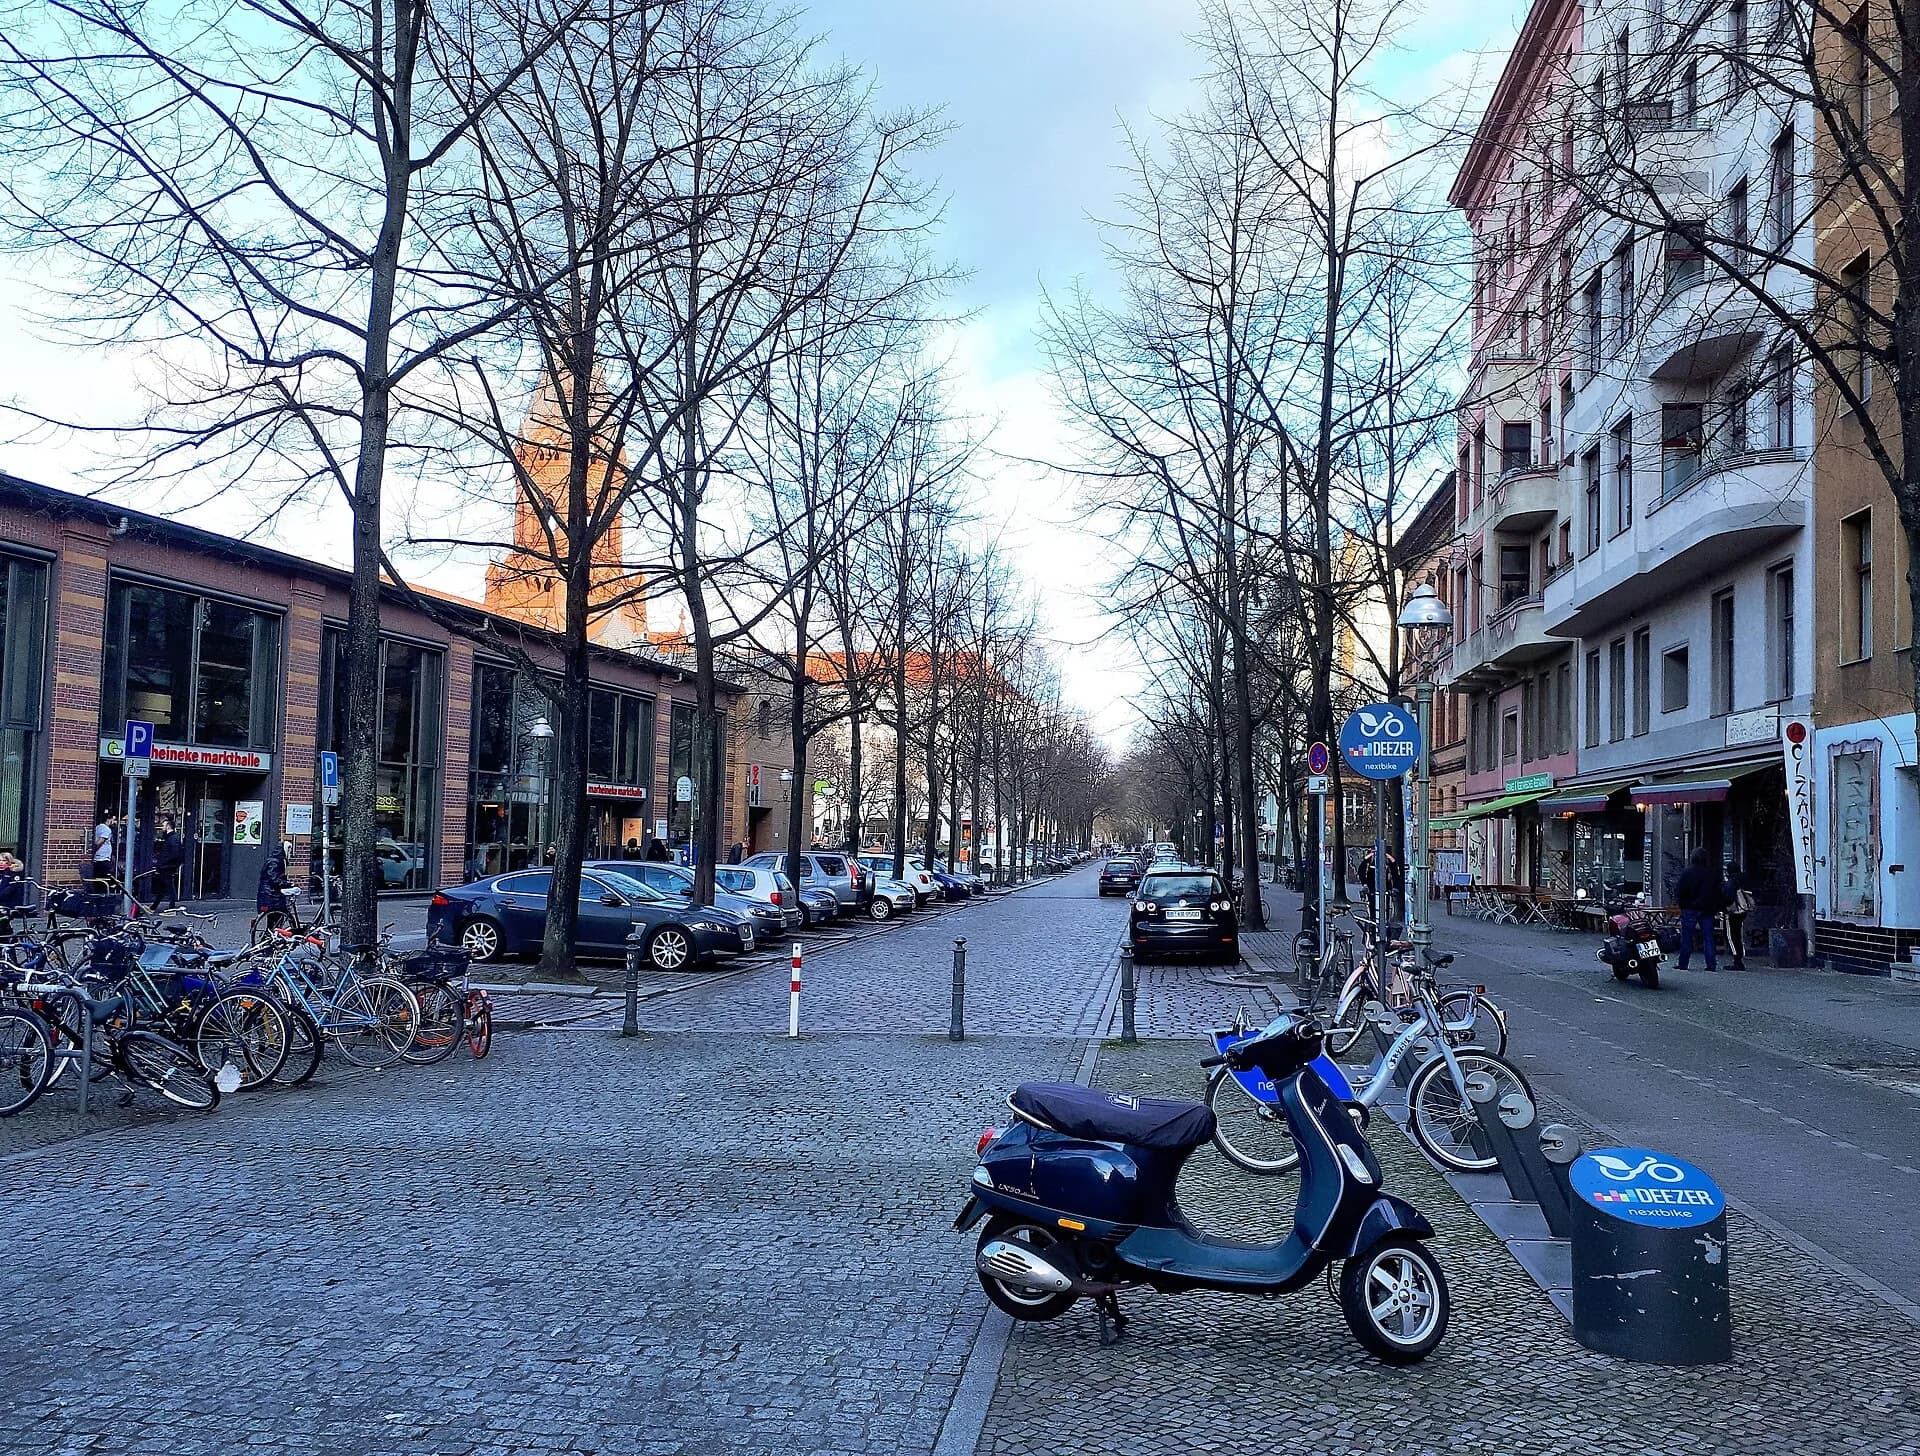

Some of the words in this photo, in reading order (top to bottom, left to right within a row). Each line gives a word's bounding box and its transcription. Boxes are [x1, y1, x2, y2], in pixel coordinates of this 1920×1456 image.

[132, 726, 147, 753] P
[151, 743, 199, 762] heineke
[200, 750, 260, 767] markthalle
[1373, 741, 1414, 757] DEEZER
[325, 757, 334, 787] P
[1365, 762, 1398, 770] nextbike
[1258, 1081, 1275, 1091] ne
[1635, 1188, 1715, 1206] DEEZER
[1628, 1208, 1693, 1218] nextbike
